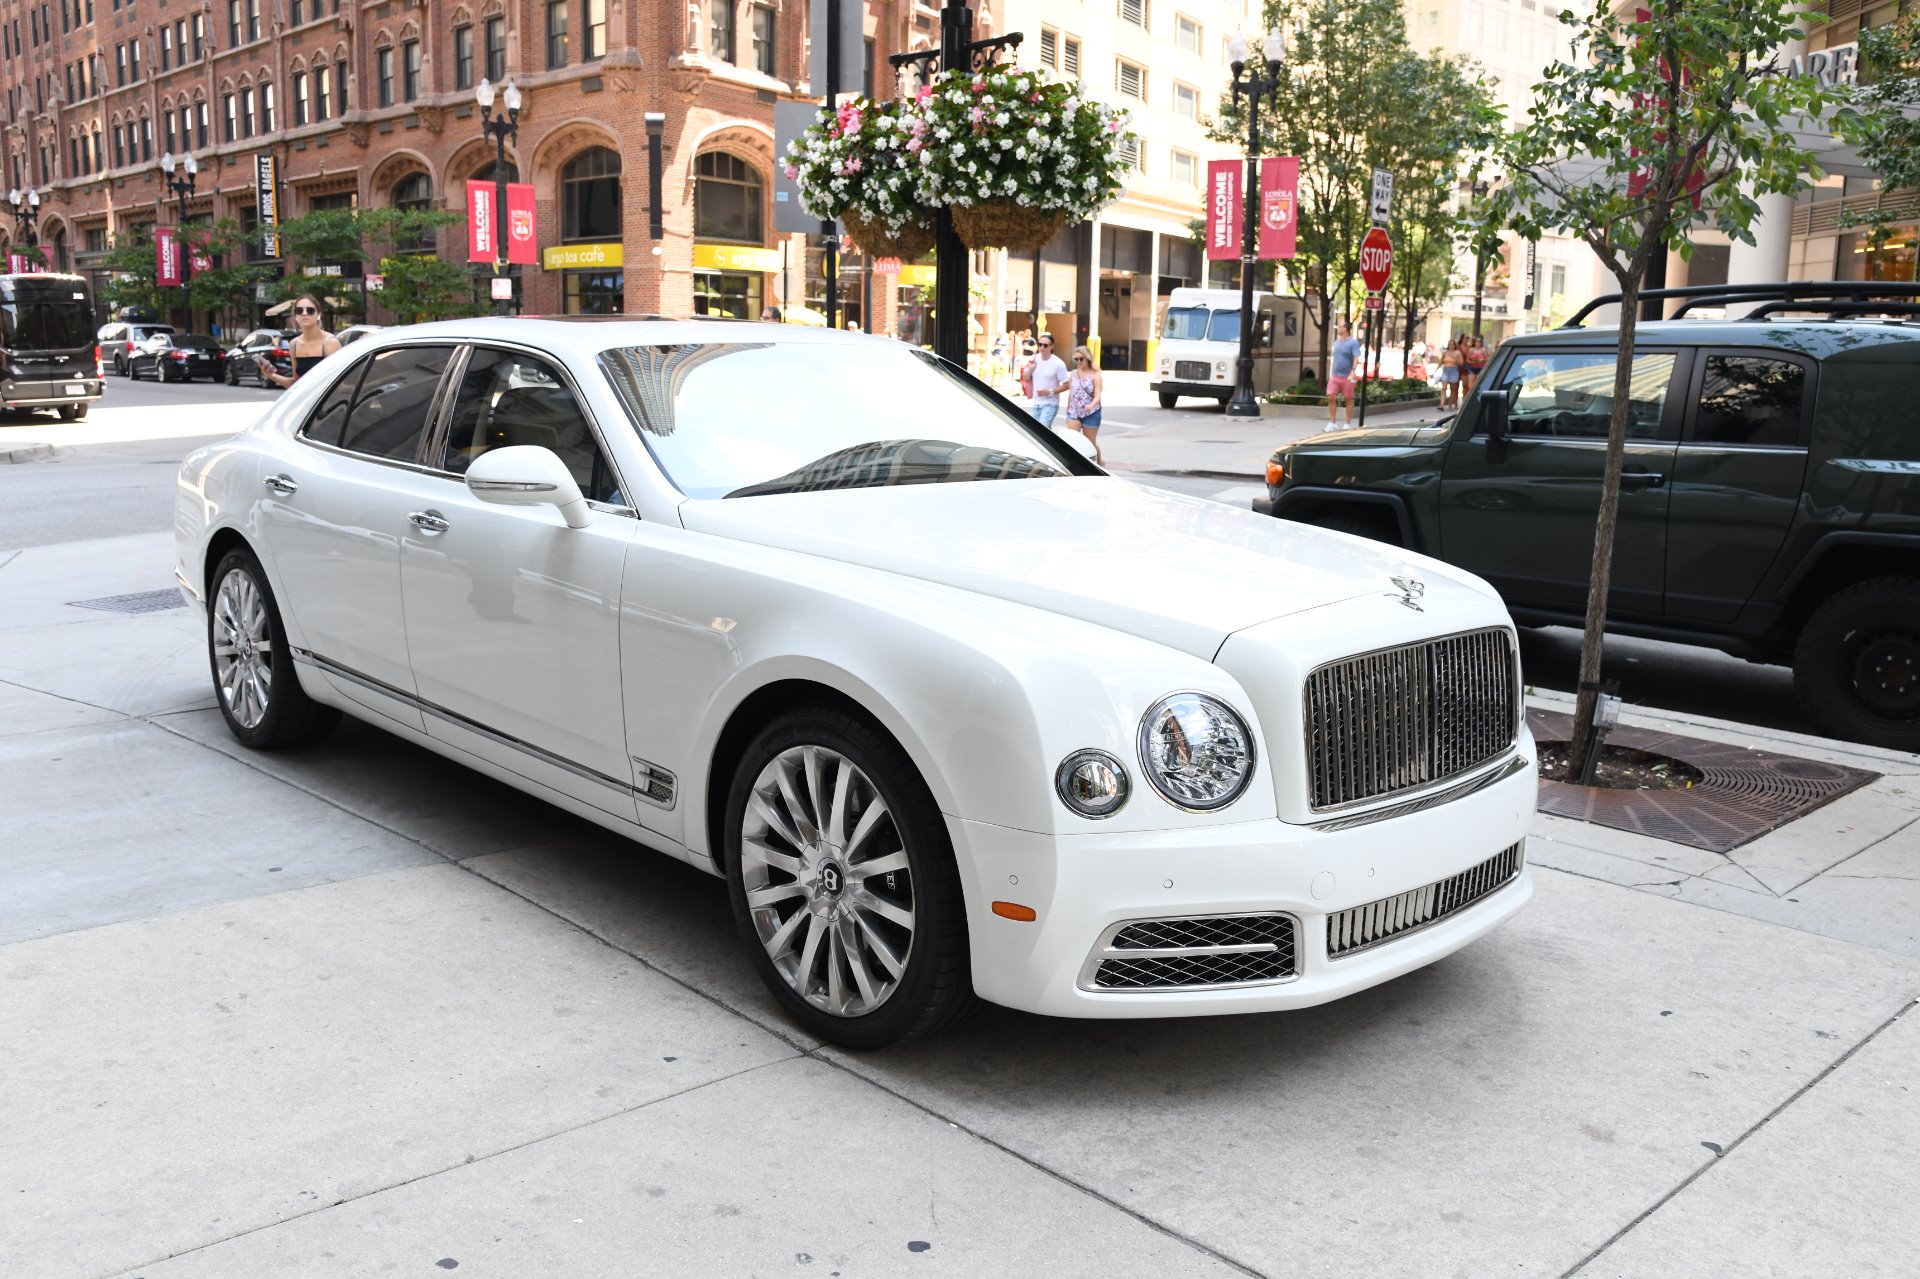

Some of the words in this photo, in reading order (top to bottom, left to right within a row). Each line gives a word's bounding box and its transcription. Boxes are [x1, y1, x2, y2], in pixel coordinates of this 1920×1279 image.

[260, 156, 273, 191] BAGELS
[1376, 174, 1391, 188] ONE
[1265, 190, 1293, 199] LOYOLA
[1375, 190, 1390, 202] WAY
[475, 190, 486, 252] WELCOME
[1215, 171, 1227, 248] WELCOME
[162, 236, 171, 279] WELCOME
[580, 245, 605, 263] café
[1362, 247, 1391, 273] STOP
